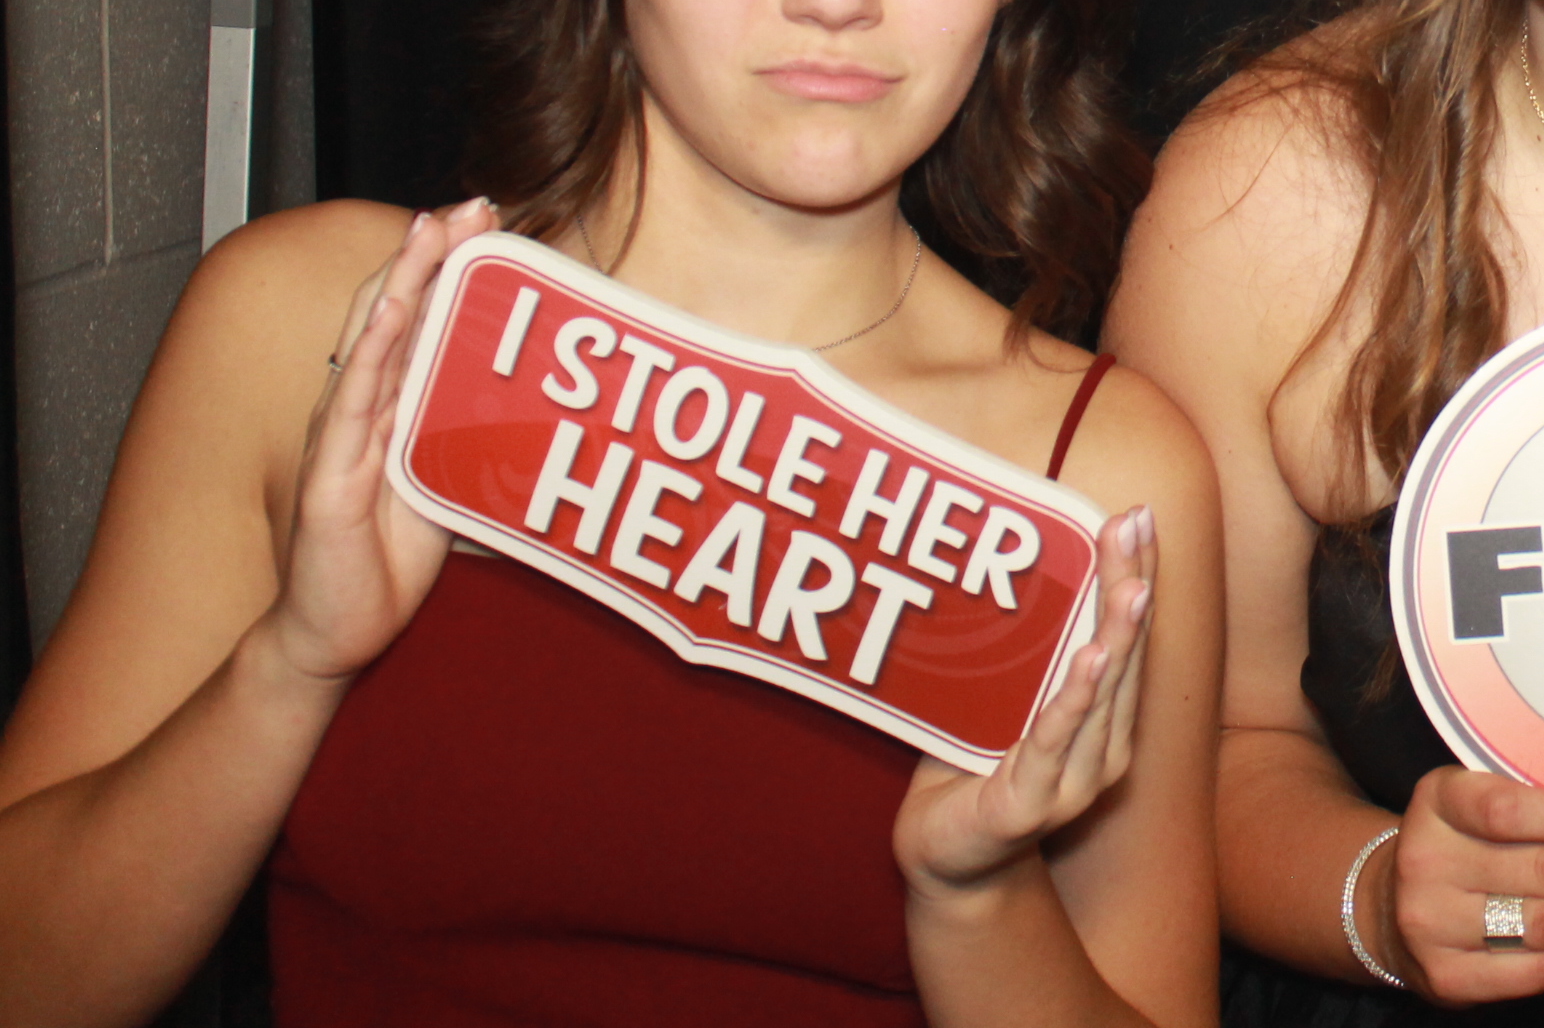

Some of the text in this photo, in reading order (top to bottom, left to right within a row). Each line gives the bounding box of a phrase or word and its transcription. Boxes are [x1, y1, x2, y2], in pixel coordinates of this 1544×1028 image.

[492, 286, 1040, 610] I STOLE HER
[524, 419, 934, 685] HEART
